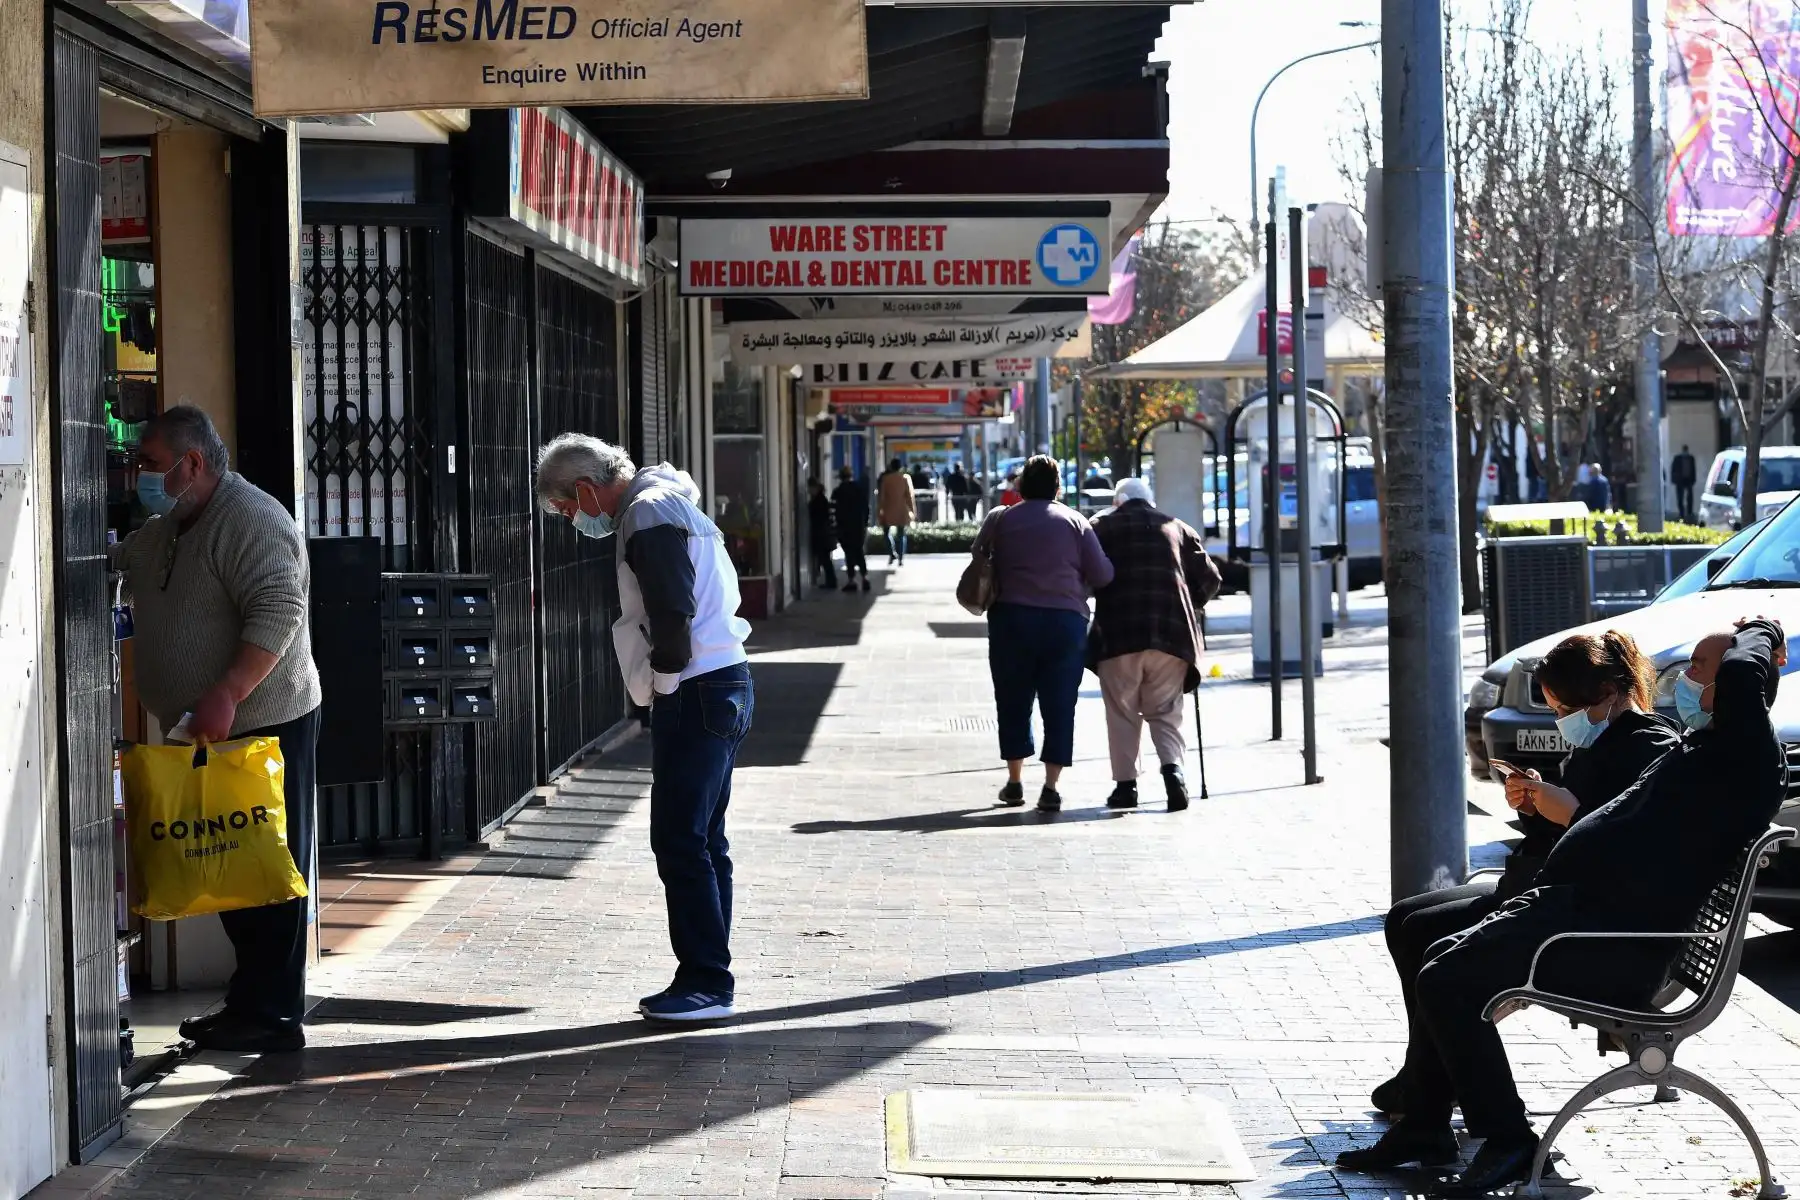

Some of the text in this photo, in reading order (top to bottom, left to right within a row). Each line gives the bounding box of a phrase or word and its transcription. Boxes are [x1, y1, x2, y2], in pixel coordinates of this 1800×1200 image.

[591, 18, 669, 40] Official
[676, 17, 743, 43] Agent
[481, 61, 647, 88] Enquire Within
[769, 225, 947, 252] WARE STREET
[690, 259, 1032, 287] MEDICAL & DENTAL CENTRE
[922, 328, 956, 347] الشعر
[909, 358, 989, 381] CAFE
[150, 805, 270, 841] CONNOR
